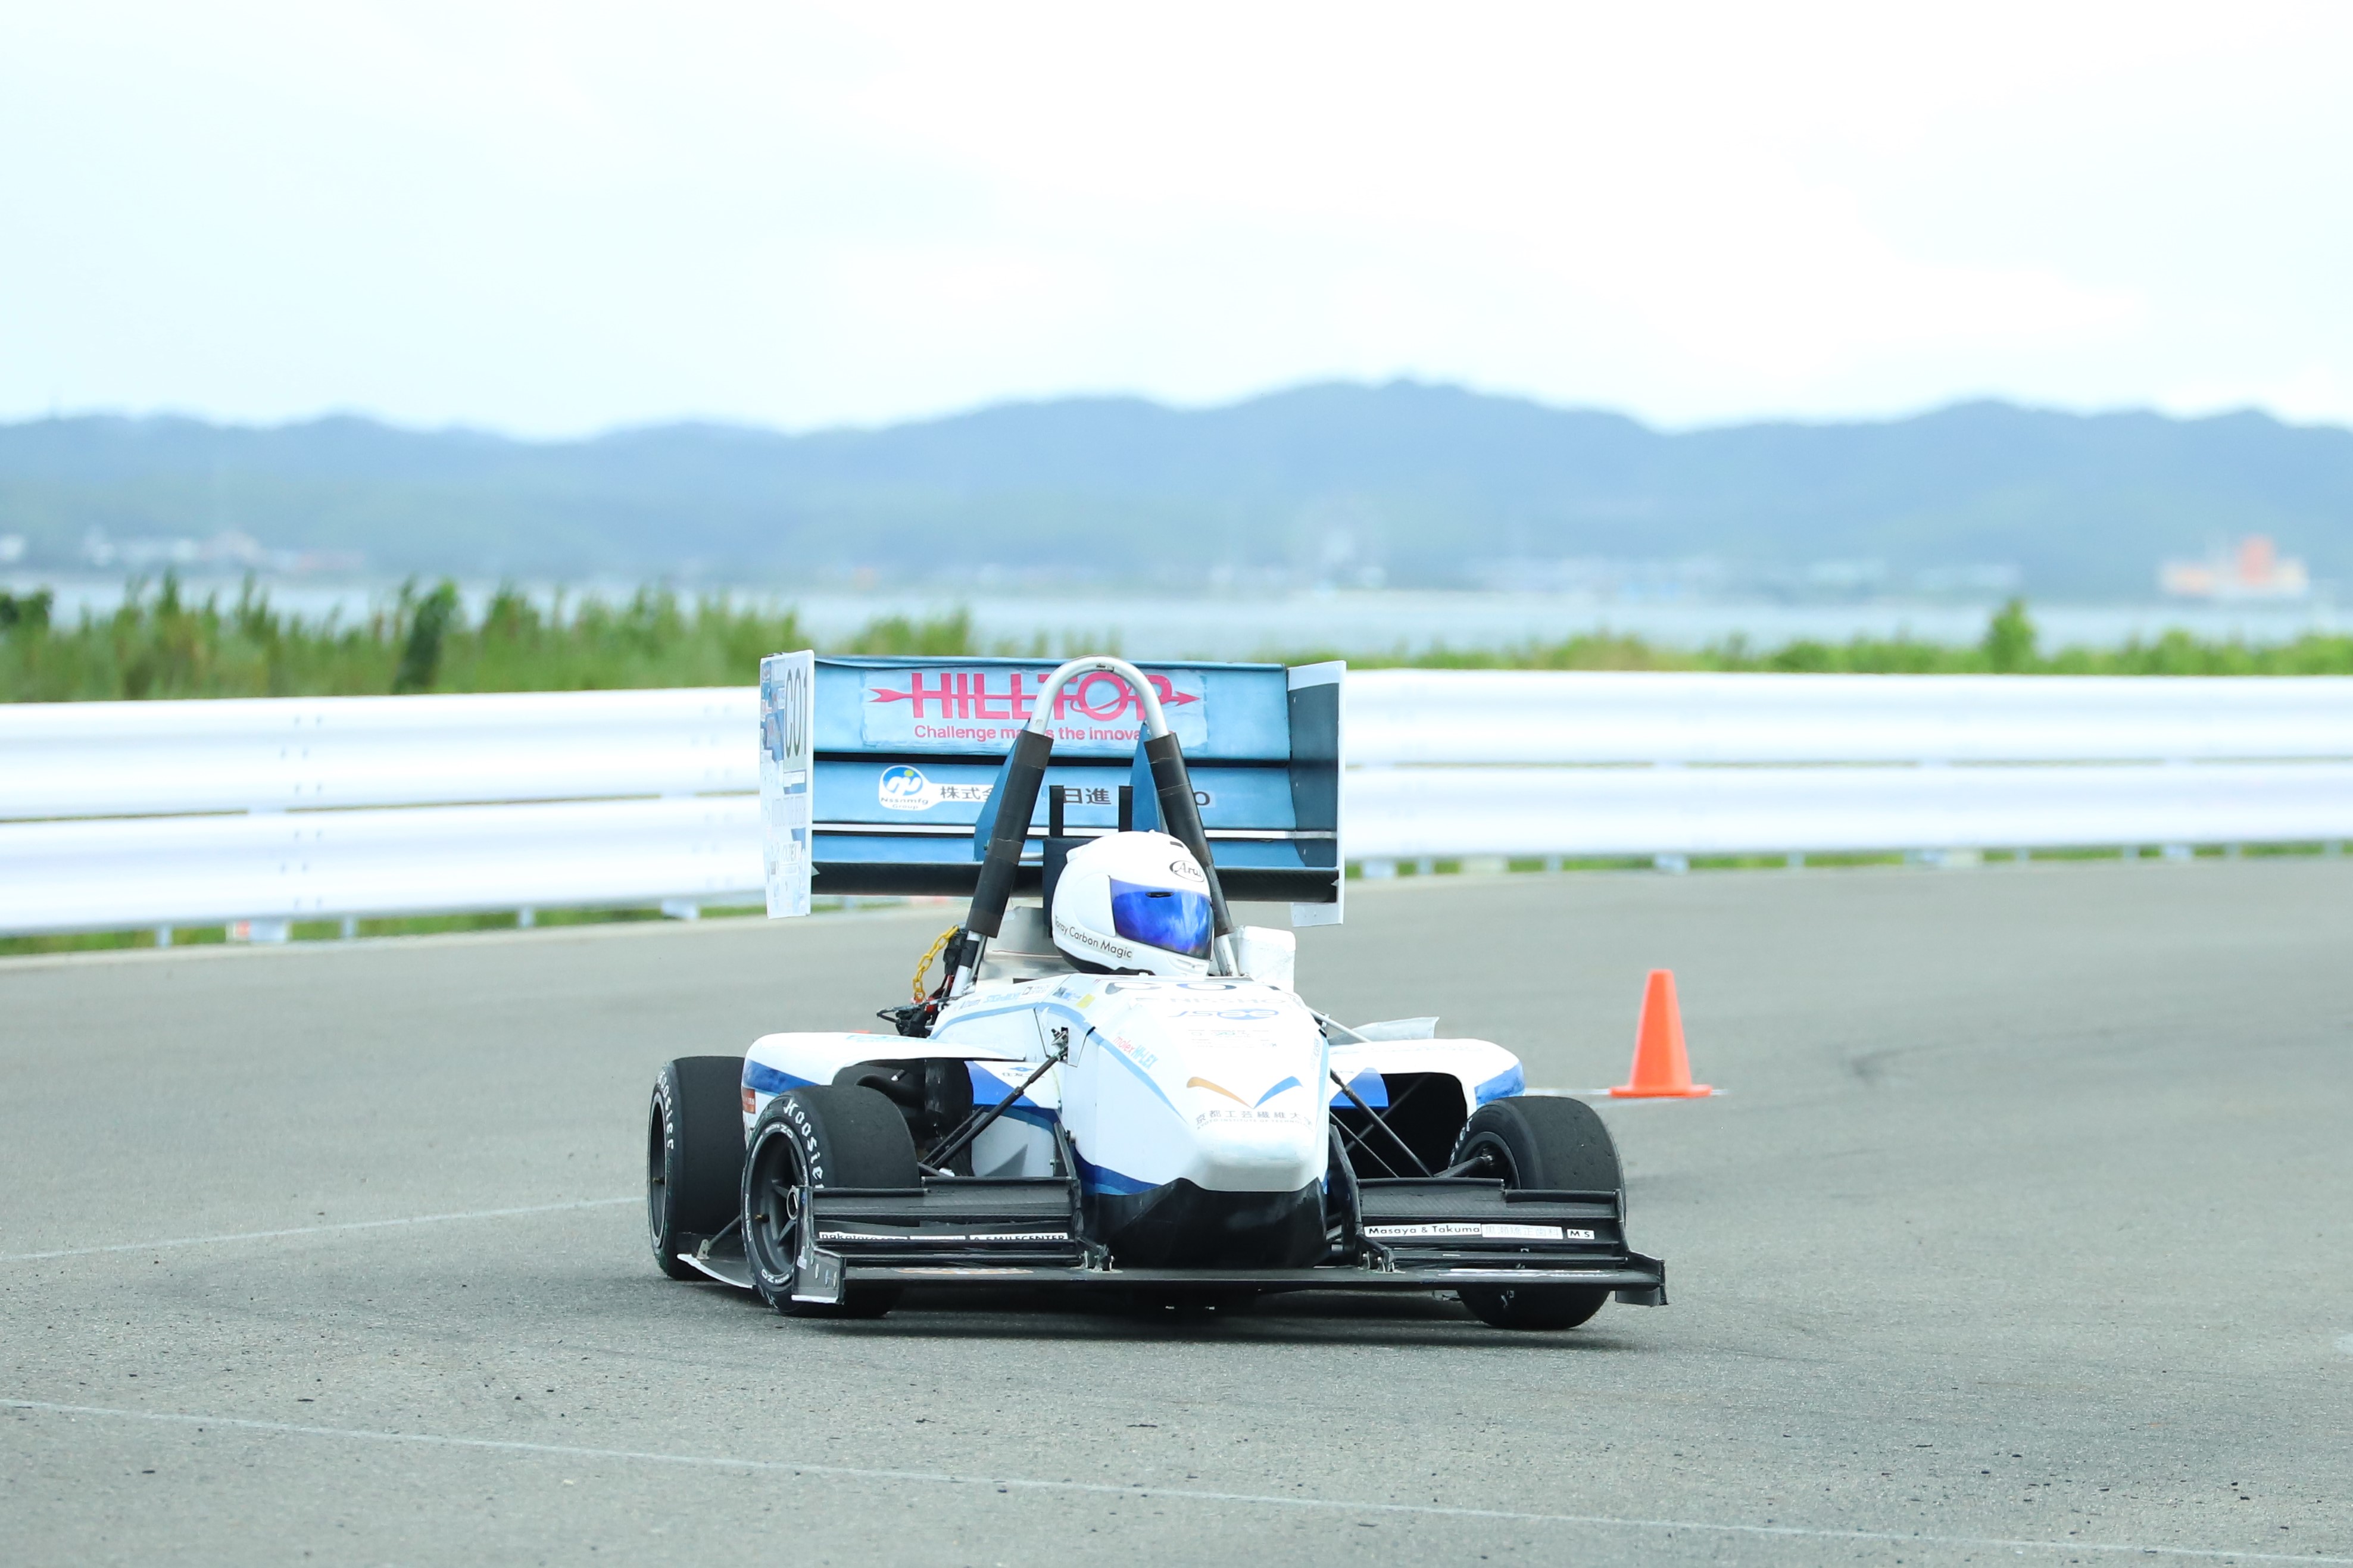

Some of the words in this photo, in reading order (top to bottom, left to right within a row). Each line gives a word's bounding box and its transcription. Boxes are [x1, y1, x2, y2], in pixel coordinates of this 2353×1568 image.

[912, 673, 1172, 721] HILLTOP
[915, 725, 996, 742] Challenge
[1001, 728, 1054, 739] mas
[1059, 727, 1085, 740] the
[1069, 926, 1099, 948] Carbon
[1100, 939, 1132, 958] Magic
[1113, 1036, 1135, 1054] molex
[1369, 1227, 1416, 1236] Masaya
[1432, 1225, 1480, 1233] Takuma
